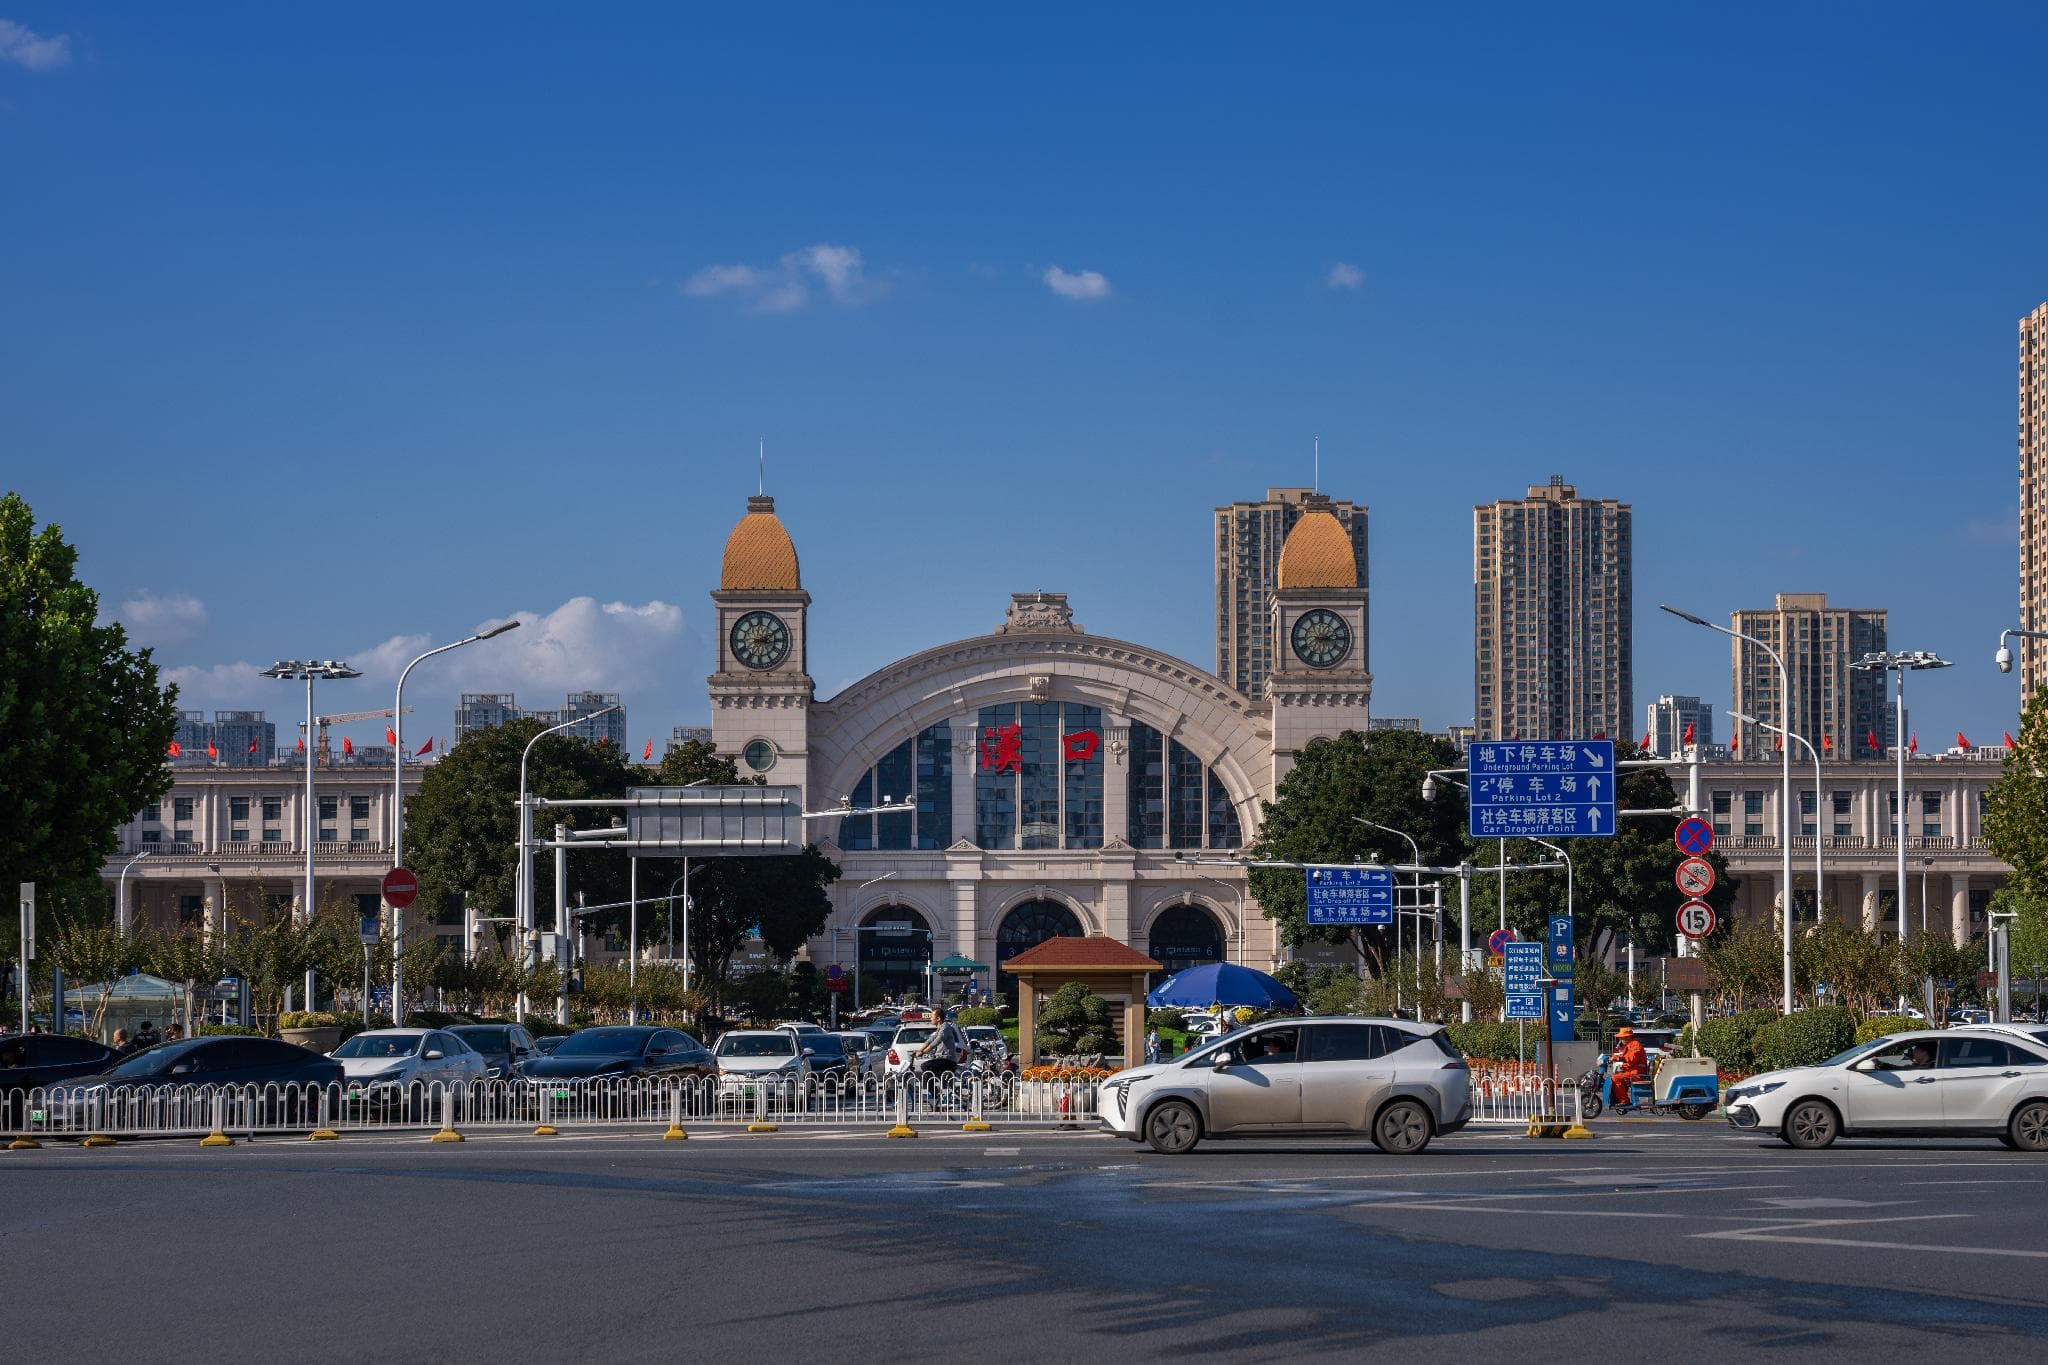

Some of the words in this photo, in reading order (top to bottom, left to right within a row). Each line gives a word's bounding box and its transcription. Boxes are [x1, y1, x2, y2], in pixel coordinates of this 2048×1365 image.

[1480, 746, 1576, 763] 地下停车场
[1483, 763, 1530, 773] Underground
[1532, 763, 1560, 772] Parking
[1561, 763, 1574, 771] Lot
[1491, 794, 1532, 804] Parking
[1535, 793, 1551, 802] Lot
[1554, 793, 1561, 801] 2
[1480, 808, 1576, 824] 社会车辆落客区
[1483, 825, 1500, 833] Car
[1504, 825, 1543, 835] Drop-off
[1548, 824, 1575, 833] Point
[1313, 906, 1371, 917] 地下停车场
[1685, 910, 1706, 930] 15
[1555, 922, 1568, 937] P
